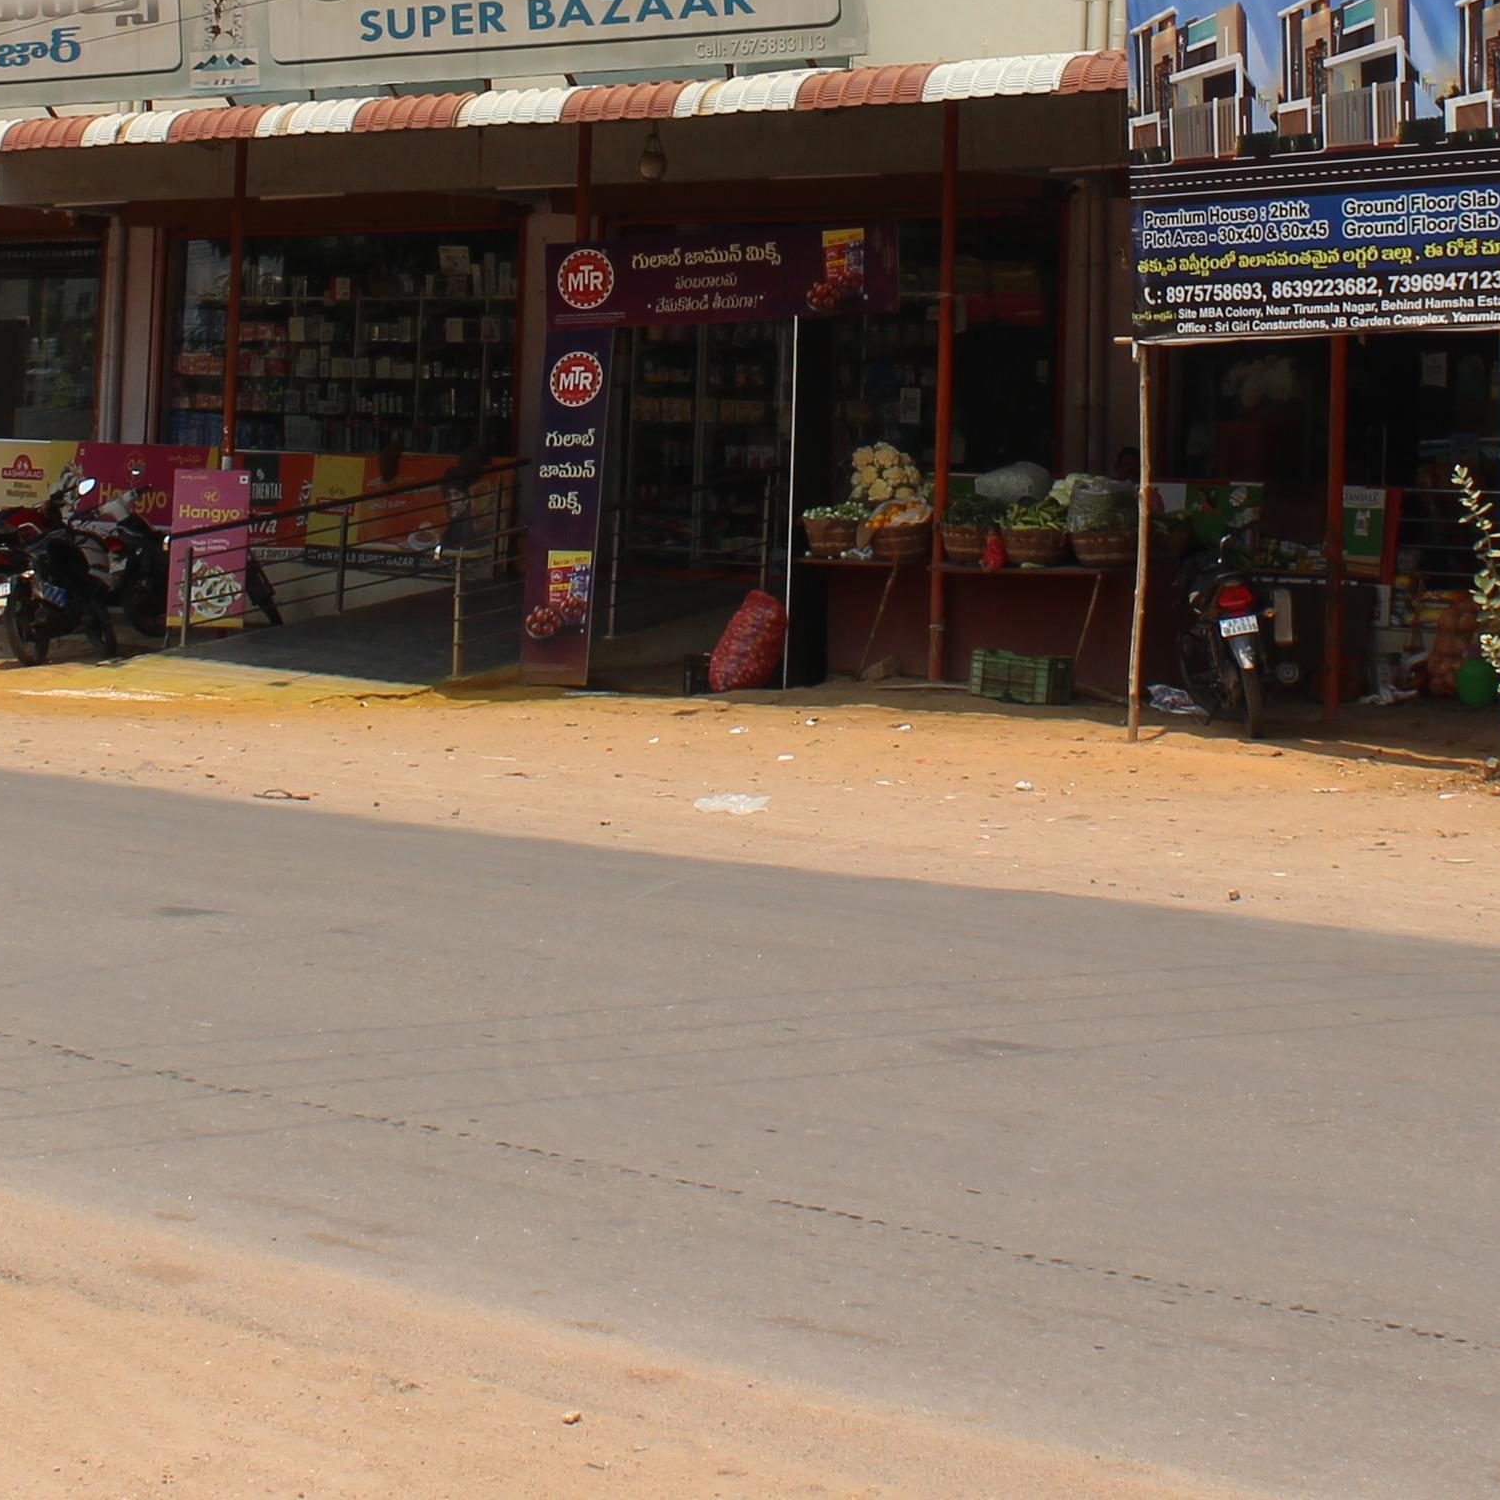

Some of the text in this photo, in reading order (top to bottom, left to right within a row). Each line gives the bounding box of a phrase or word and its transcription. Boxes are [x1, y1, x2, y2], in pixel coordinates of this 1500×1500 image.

[359, 0, 508, 43] SUPER
[1143, 209, 1205, 228] Premium
[1208, 207, 1257, 224] House
[1269, 201, 1309, 220] 2bhk
[1342, 198, 1408, 218] Ground
[1410, 194, 1458, 213] Floor
[1458, 190, 1500, 209] Slab
[1143, 231, 1172, 249] Plot
[1174, 229, 1208, 247] Area
[1218, 226, 1262, 244] 30x40
[1265, 224, 1279, 241] &
[1281, 221, 1329, 240] 30x45
[1342, 220, 1408, 240] Ground
[1410, 216, 1458, 235] Floor
[1459, 212, 1500, 232] Slab
[631, 241, 782, 270] గులాబ్ జామున్ మిక్స్
[1137, 259, 1178, 276] తక్కువ
[1424, 244, 1443, 258] ఈ
[568, 262, 604, 292] MTR
[1166, 282, 1267, 303] 8975758693,
[1272, 276, 1382, 299] 8639223682,
[1177, 308, 1197, 320] Site
[1200, 306, 1224, 318] MBA
[1225, 306, 1263, 320] Colony,
[1266, 304, 1295, 317] Near
[1297, 301, 1340, 314] Tirumala
[1342, 299, 1379, 315] Nagar,
[1381, 299, 1422, 311] Behind
[1425, 296, 1474, 309] Hamsha
[1177, 322, 1207, 334] Office
[1214, 321, 1230, 332] Sri
[1231, 320, 1251, 331] Giri
[1331, 315, 1348, 328] JB
[1350, 314, 1391, 328] Garden
[1393, 313, 1449, 328] Complex,
[559, 365, 593, 392] MTR
[545, 428, 596, 449] గులాబ్
[539, 460, 596, 480] జామున్
[179, 504, 240, 523] Hangyo
[547, 491, 583, 516] మిక్స్
